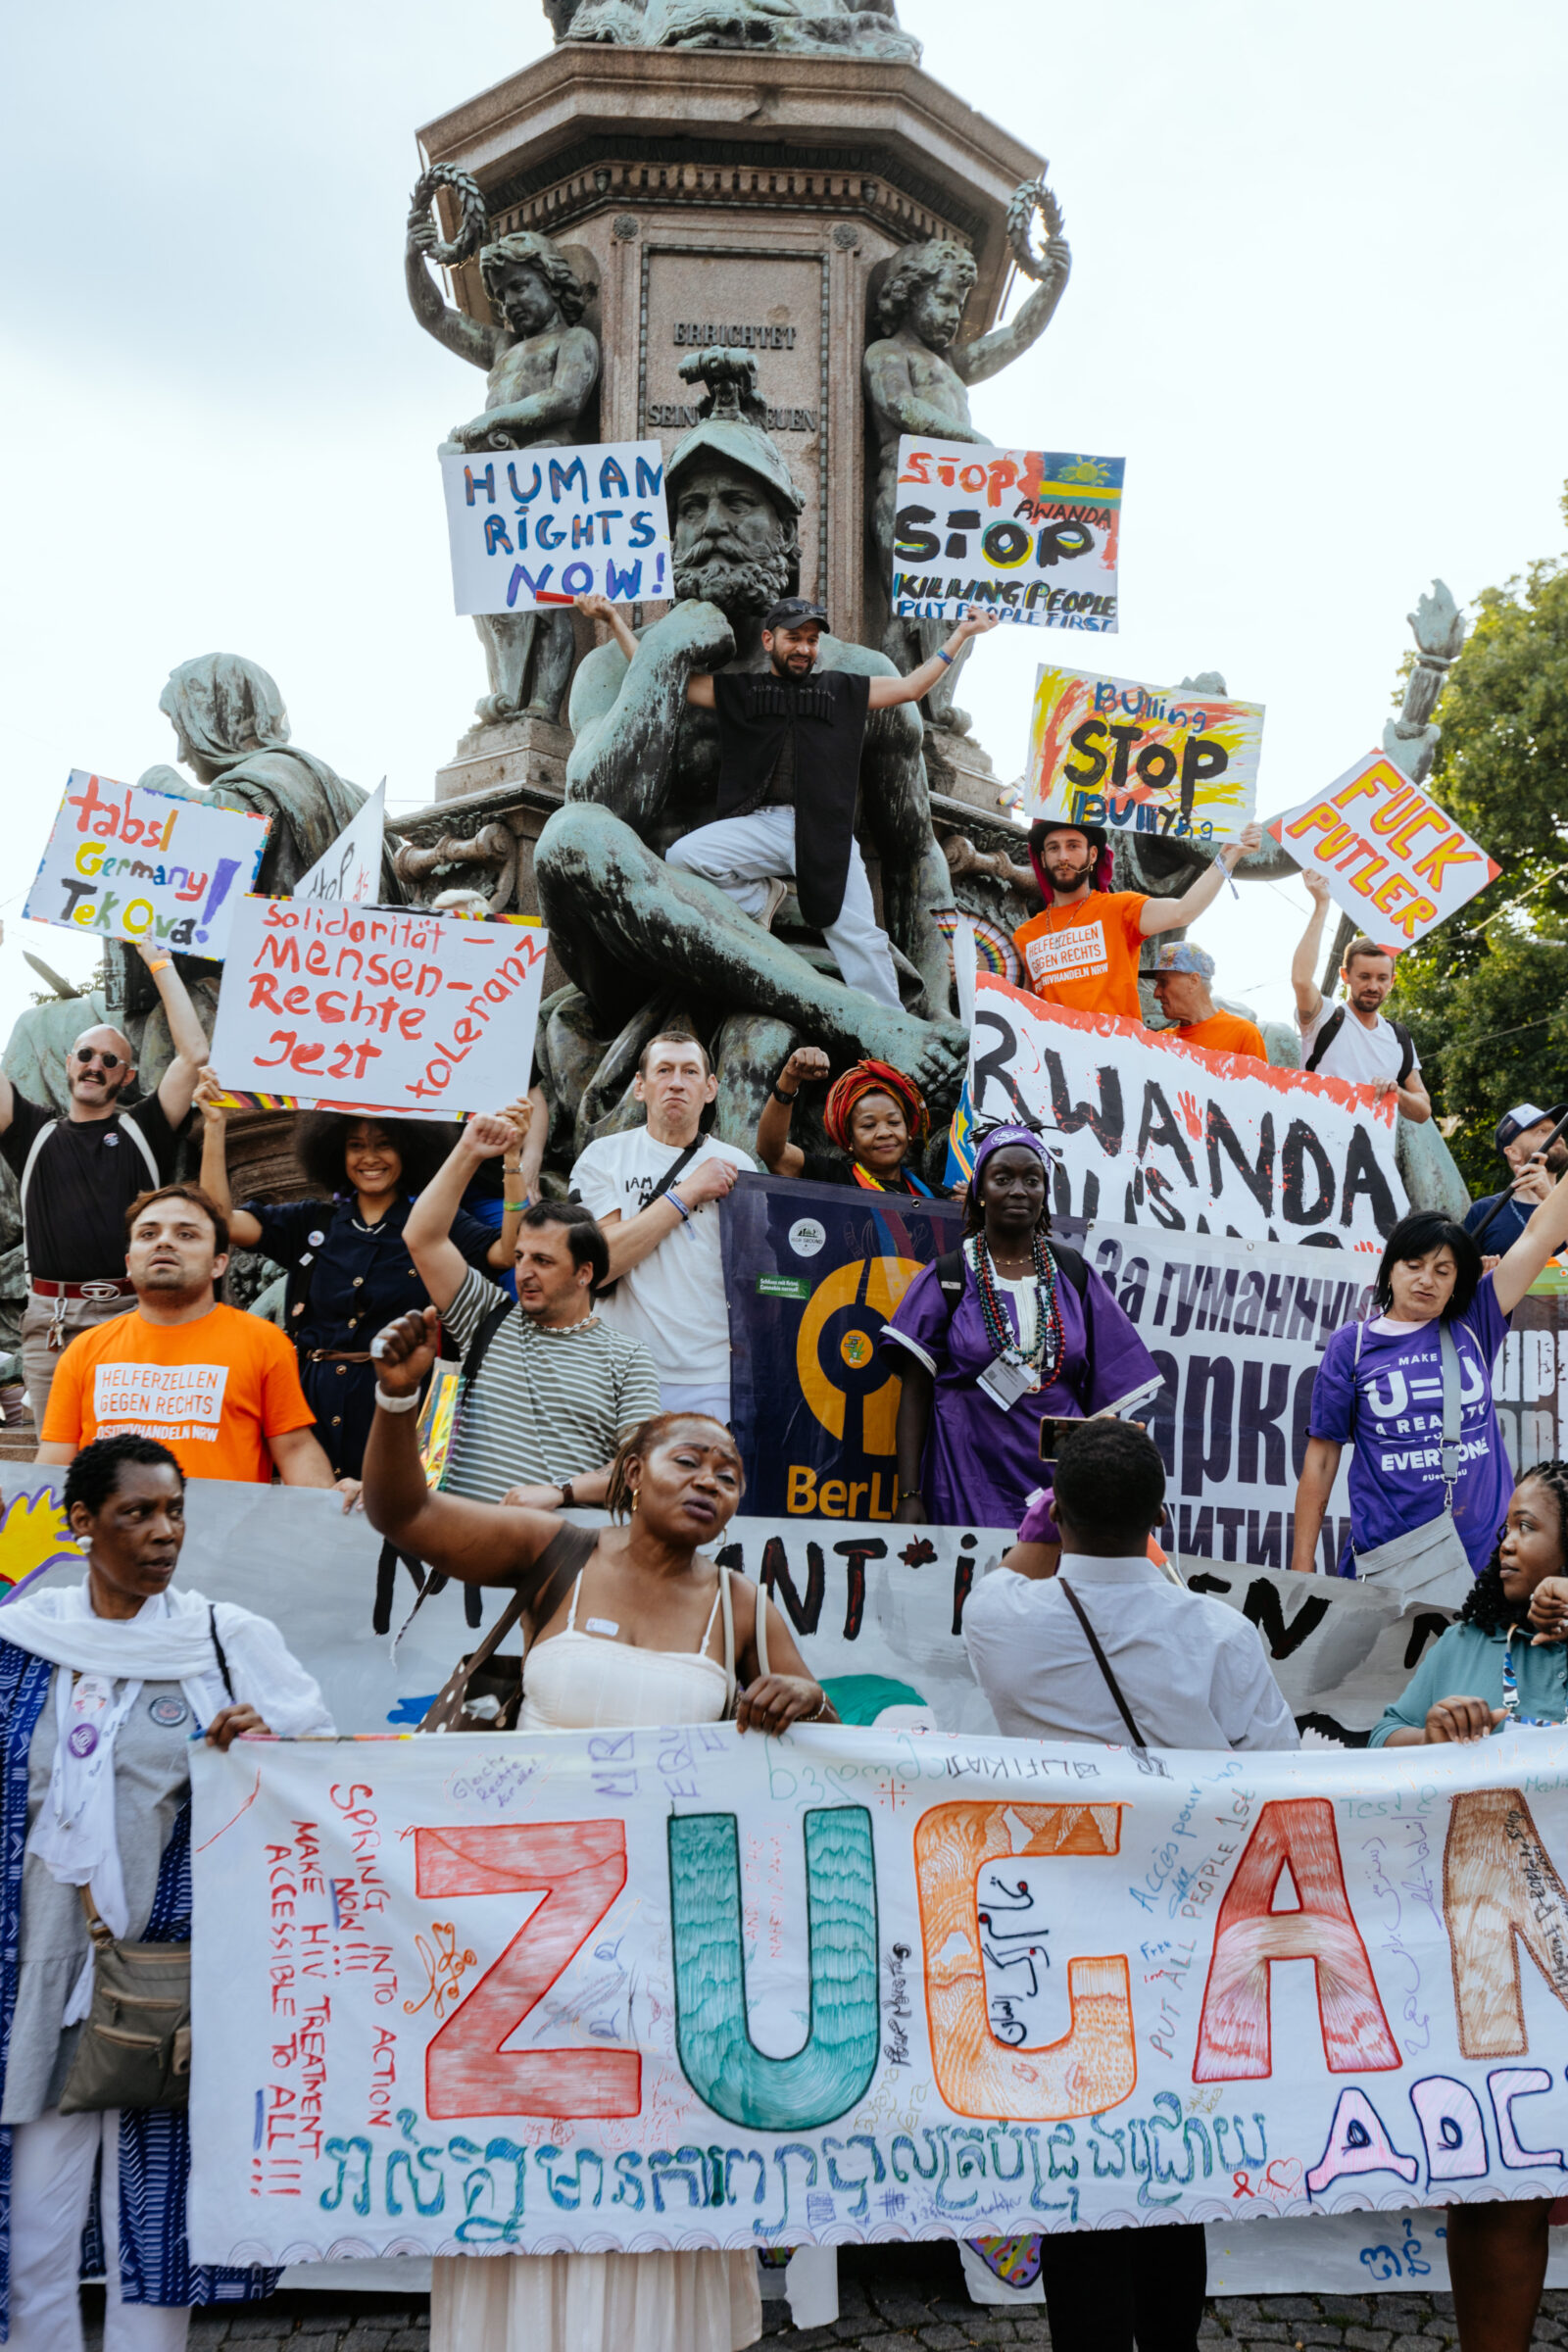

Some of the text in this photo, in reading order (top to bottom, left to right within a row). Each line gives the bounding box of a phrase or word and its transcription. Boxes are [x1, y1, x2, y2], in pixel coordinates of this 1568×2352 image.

[673, 322, 797, 350] ERRICHTET
[465, 456, 663, 507] HUMAN
[898, 452, 1019, 508] STOP
[484, 506, 657, 556] RIGHTS
[895, 504, 1095, 569] STOP
[1012, 499, 1112, 530] RWANDA
[506, 552, 665, 608] NOW!
[1023, 579, 1117, 618] PEOPLE
[898, 600, 947, 618] PUT
[1046, 612, 1114, 632] FIRST
[1063, 718, 1229, 819] STOP
[1330, 759, 1484, 893] FUCK
[1284, 801, 1438, 940] PUTLER
[1060, 943, 1101, 964] RECHTS
[1091, 962, 1108, 976] NRW
[248, 972, 426, 1041] Rechte
[974, 1009, 1401, 1241] RWANDA
[101, 1368, 219, 1391] HELFERZELLEN
[1398, 1352, 1438, 1366] MAKE
[100, 1393, 213, 1415] GEGEN RECHTS
[1375, 1422, 1387, 1436] A
[192, 1424, 220, 1443] NRW
[1182, 1840, 1239, 1921] PEOPLE
[263, 1843, 297, 2018] ACCESSIBLE
[329, 1783, 397, 2129] SPRING INTO ACTION
[290, 1820, 333, 2162] MAKE HIV TREATMENT
[1163, 1939, 1198, 1992] ALL
[270, 2033, 297, 2070] TO
[1149, 1995, 1183, 2060] PUT
